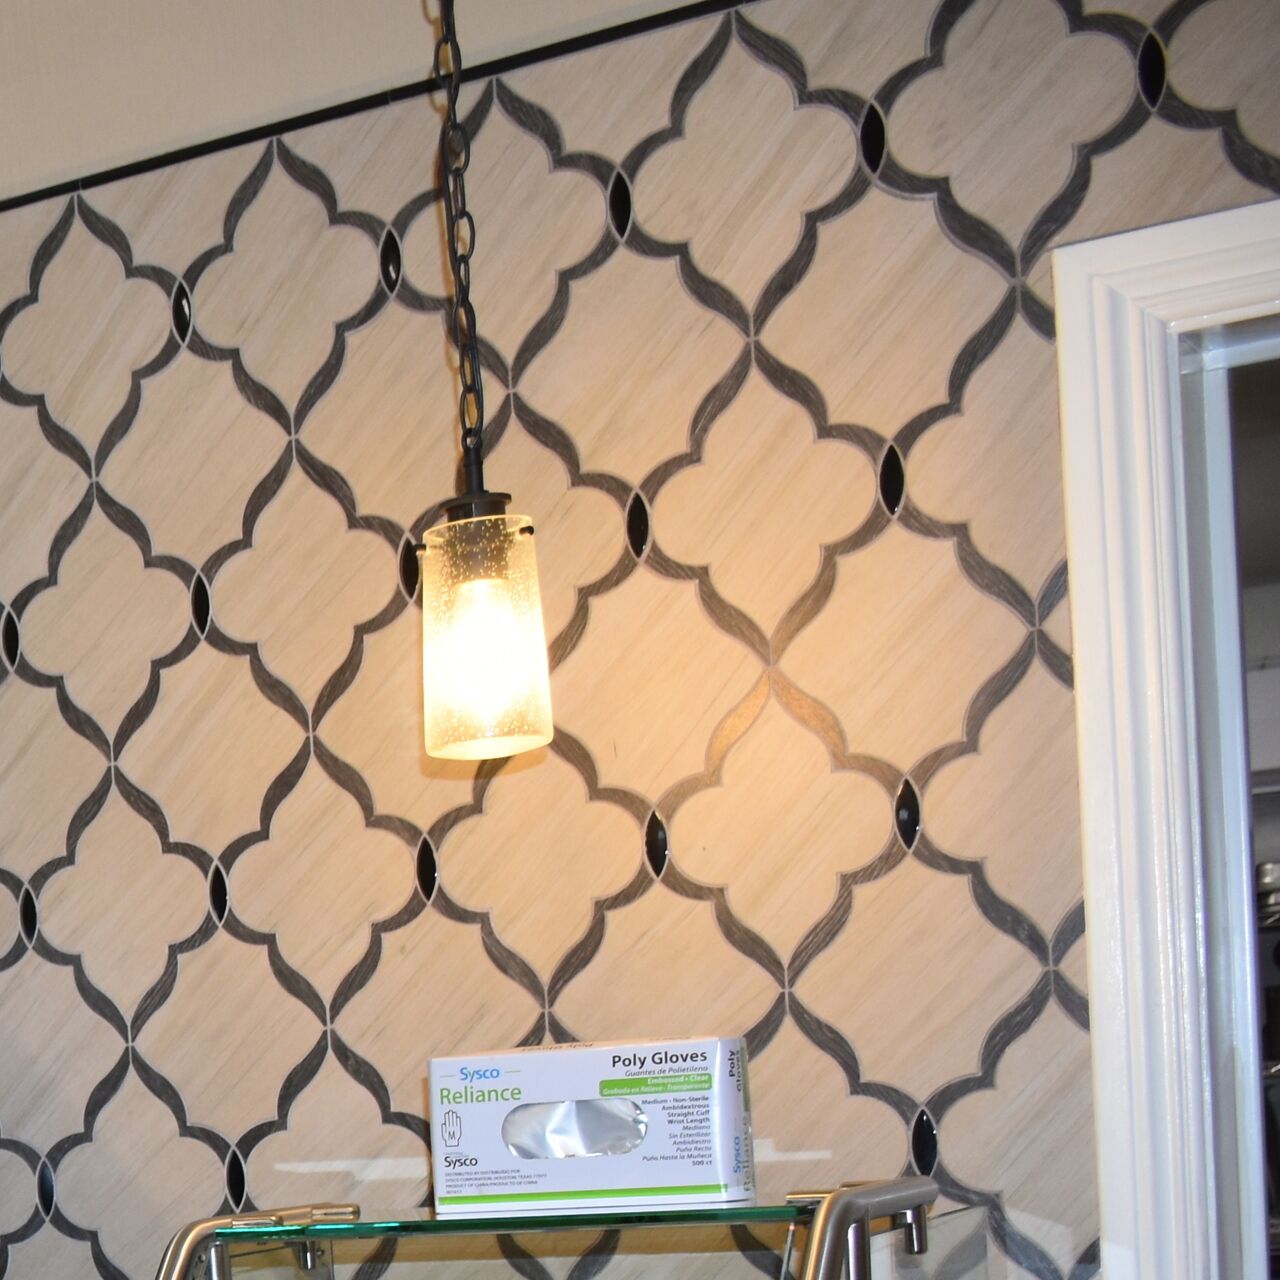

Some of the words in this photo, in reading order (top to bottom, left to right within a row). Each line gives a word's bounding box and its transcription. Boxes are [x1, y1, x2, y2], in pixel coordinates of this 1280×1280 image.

[612, 1053, 647, 1069] Poly
[651, 1051, 708, 1065] Gloves
[728, 1049, 736, 1077] Poly
[459, 1067, 500, 1083] Sysco
[625, 1069, 656, 1077] Guantes
[668, 1065, 709, 1074] Polietileno
[440, 1085, 522, 1105] Reliance
[448, 1130, 456, 1140] M
[444, 1156, 478, 1170] Sysco
[733, 1136, 741, 1174] Sysco
